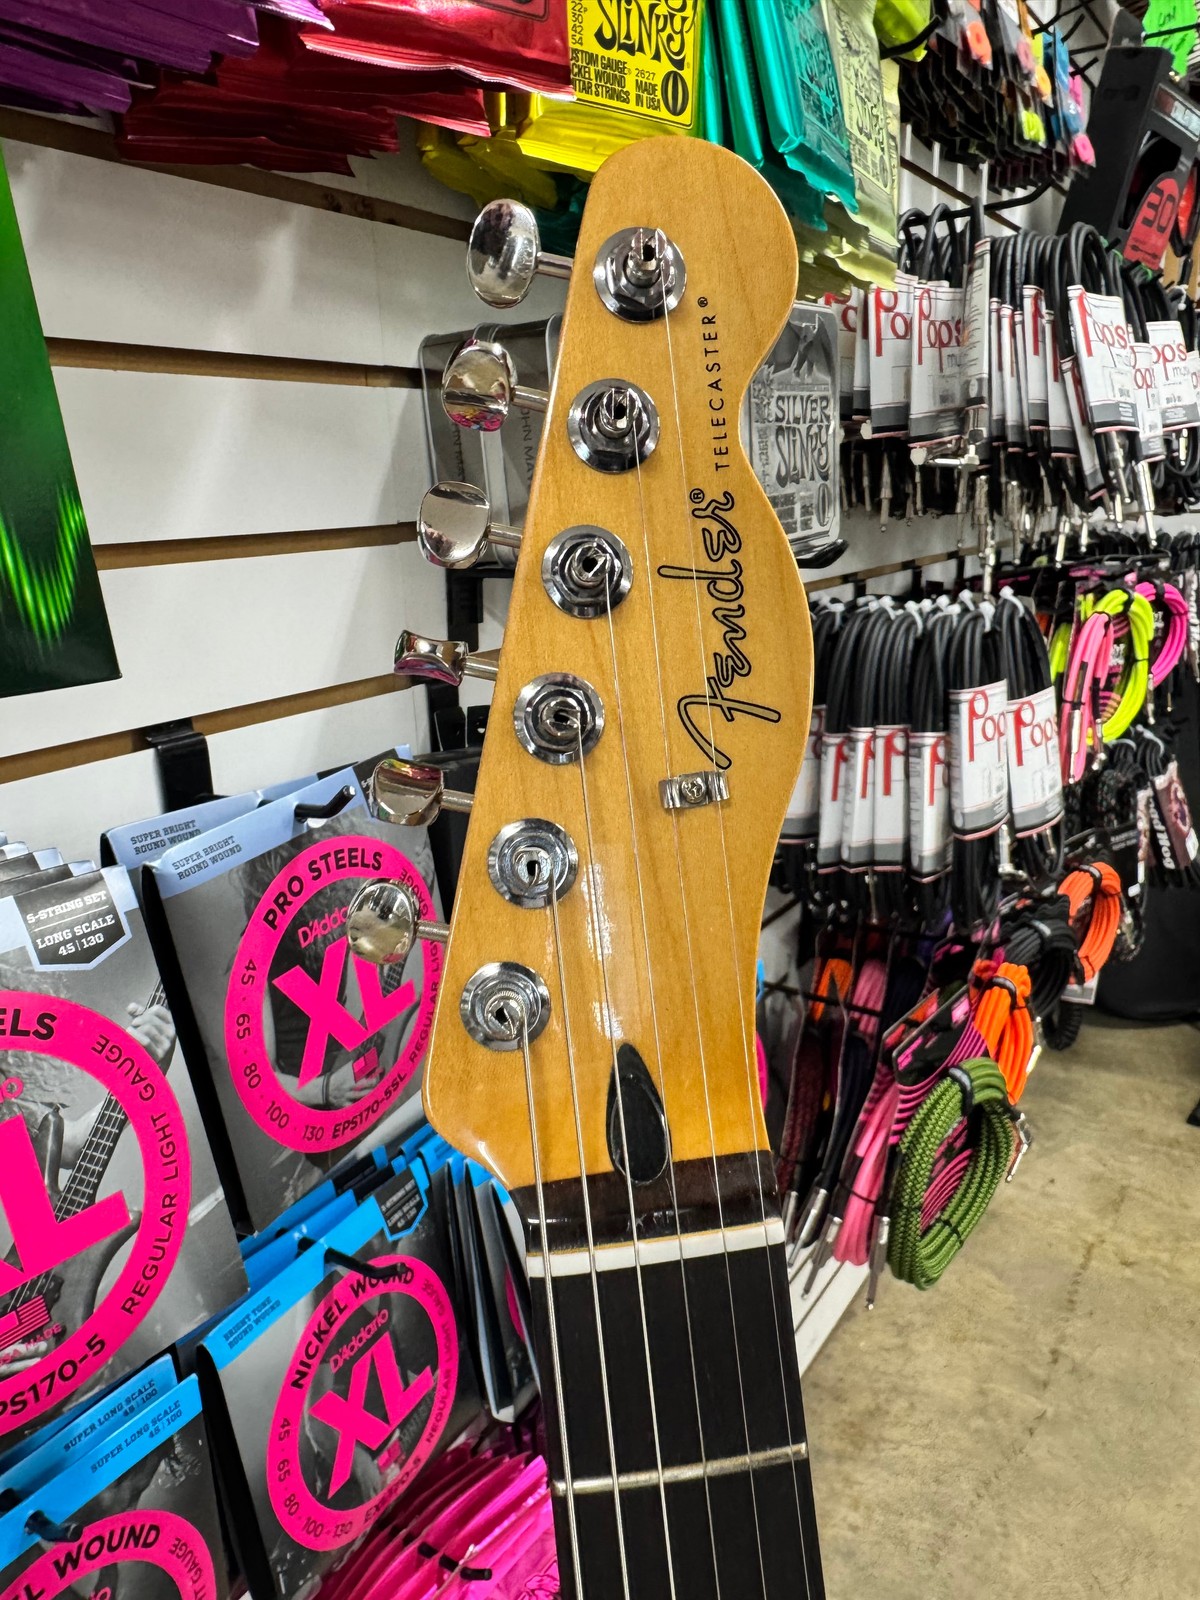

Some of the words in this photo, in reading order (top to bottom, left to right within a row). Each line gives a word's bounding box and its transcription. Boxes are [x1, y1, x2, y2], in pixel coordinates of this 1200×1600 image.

[571, 12, 584, 24] 30
[571, 24, 584, 36] 42
[571, 33, 584, 46] 54
[594, 69, 626, 90] WOUND
[601, 55, 627, 76] GAUGE
[635, 68, 656, 82] 2627
[595, 84, 630, 105] STRINGS
[636, 79, 658, 98] MADE
[636, 93, 644, 108] IN
[646, 96, 661, 113] USA
[775, 394, 830, 425] SILVER
[775, 424, 829, 488] SLINKY
[130, 829, 162, 846] SUPER
[163, 819, 197, 837] BRIGHT
[133, 839, 166, 856] ROUND
[167, 828, 202, 845] WOUND
[171, 850, 204, 871] SUPER
[202, 835, 236, 857] BRIGHT
[177, 860, 209, 881] ROUND
[209, 843, 243, 866] WOUND
[83, 890, 107, 905] SET
[263, 875, 305, 931] PRO
[307, 847, 384, 881] STEELS
[36, 928, 73, 949] LONG
[73, 914, 116, 936] SCALE
[241, 958, 258, 986] 45
[271, 933, 416, 1090] XL
[236, 1013, 252, 1041] 65
[91, 1033, 156, 1102] GAUGE
[243, 1062, 262, 1090] 80
[265, 1100, 290, 1130] 100
[302, 1123, 325, 1142] 130
[150, 1112, 179, 1182] LIGHT
[120, 1192, 178, 1316] REGULAR
[290, 1299, 348, 1390] NICKEL
[63, 1422, 98, 1453] SUPER
[97, 1401, 124, 1427] LONG
[124, 1379, 156, 1406] SCALE
[308, 1330, 435, 1500] XL
[90, 1442, 124, 1474] SUPER
[123, 1422, 150, 1448] LONG
[150, 1399, 181, 1427] SCALE
[278, 1417, 291, 1442] 45
[276, 1458, 292, 1483] 65
[284, 1493, 300, 1517] 80
[302, 1516, 325, 1539] 100
[53, 1523, 161, 1581] WOUND
[168, 1536, 203, 1584] GAUGE
